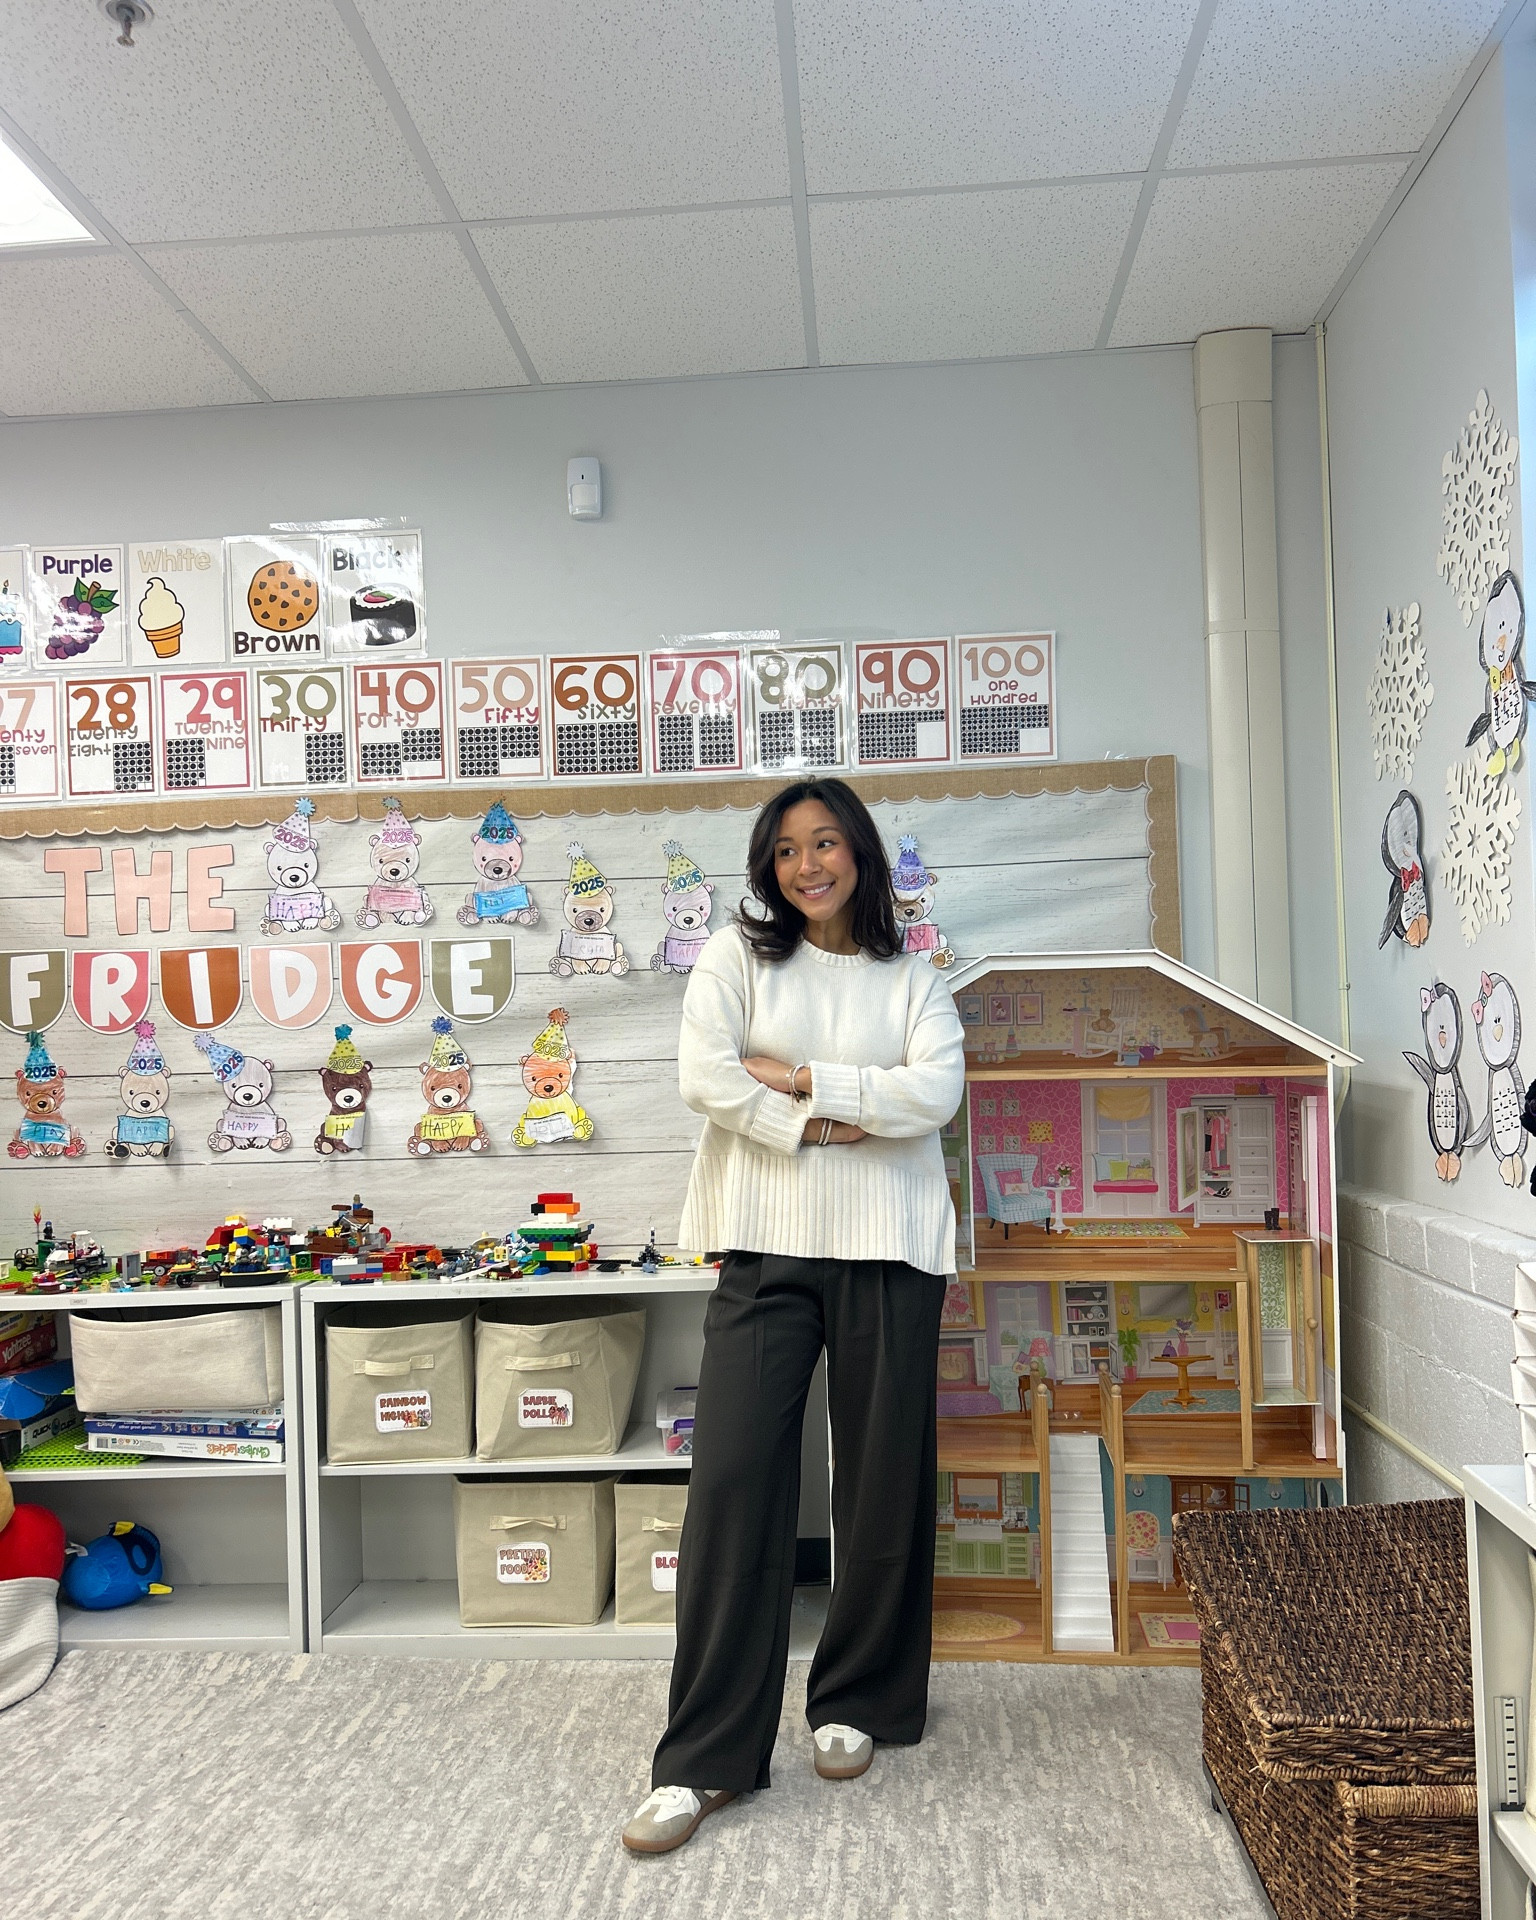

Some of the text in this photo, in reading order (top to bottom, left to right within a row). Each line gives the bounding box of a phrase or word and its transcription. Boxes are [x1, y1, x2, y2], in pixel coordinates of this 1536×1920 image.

[43, 554, 113, 578] Purple
[137, 547, 212, 573] White
[234, 631, 320, 655] Brown
[964, 644, 1045, 681] 100
[756, 655, 836, 705] 80
[862, 649, 941, 696] 90
[459, 666, 534, 713] 50
[554, 663, 635, 711] 60
[656, 659, 733, 708] 70
[179, 678, 242, 724] 29
[263, 675, 337, 723] 30
[360, 670, 436, 717] 40
[778, 691, 843, 710] Eighty
[859, 690, 940, 709] Ninety
[970, 692, 1038, 706] Hundred
[70, 683, 137, 731] 28
[484, 706, 540, 724] Fifty
[174, 718, 246, 735] Twenty
[259, 715, 328, 733] Thirty
[357, 711, 419, 729] Forty
[0, 728, 46, 743] enty
[69, 724, 138, 741] Twenty
[69, 743, 112, 757] Eight
[206, 735, 247, 750] Nine
[275, 828, 308, 851] 2025
[381, 830, 414, 843] 2025
[481, 826, 515, 839] 2025
[572, 875, 605, 895] 2025
[893, 872, 927, 886] 2025
[44, 843, 236, 937] THE
[275, 901, 321, 919] HAPPY
[9, 941, 495, 1026] FRIDGE
[536, 1041, 568, 1060] 2025
[131, 1058, 162, 1071] 2025
[217, 1051, 243, 1081] 2025
[329, 1058, 363, 1071] 2025
[433, 1052, 464, 1068] 2025
[25, 1065, 57, 1079] 2025
[227, 1120, 259, 1132] HAPPY
[423, 1118, 464, 1138] HAPPY
[2, 1334, 32, 1364] Yahtzee
[379, 1395, 427, 1409] RAINBOW
[522, 1395, 557, 1406] BARBIE
[206, 1443, 238, 1456] Ladders
[240, 1444, 271, 1459] Chutes
[499, 1549, 547, 1561] PRETEND
[655, 1556, 679, 1569] BLO
[500, 1563, 529, 1575] FOOD
